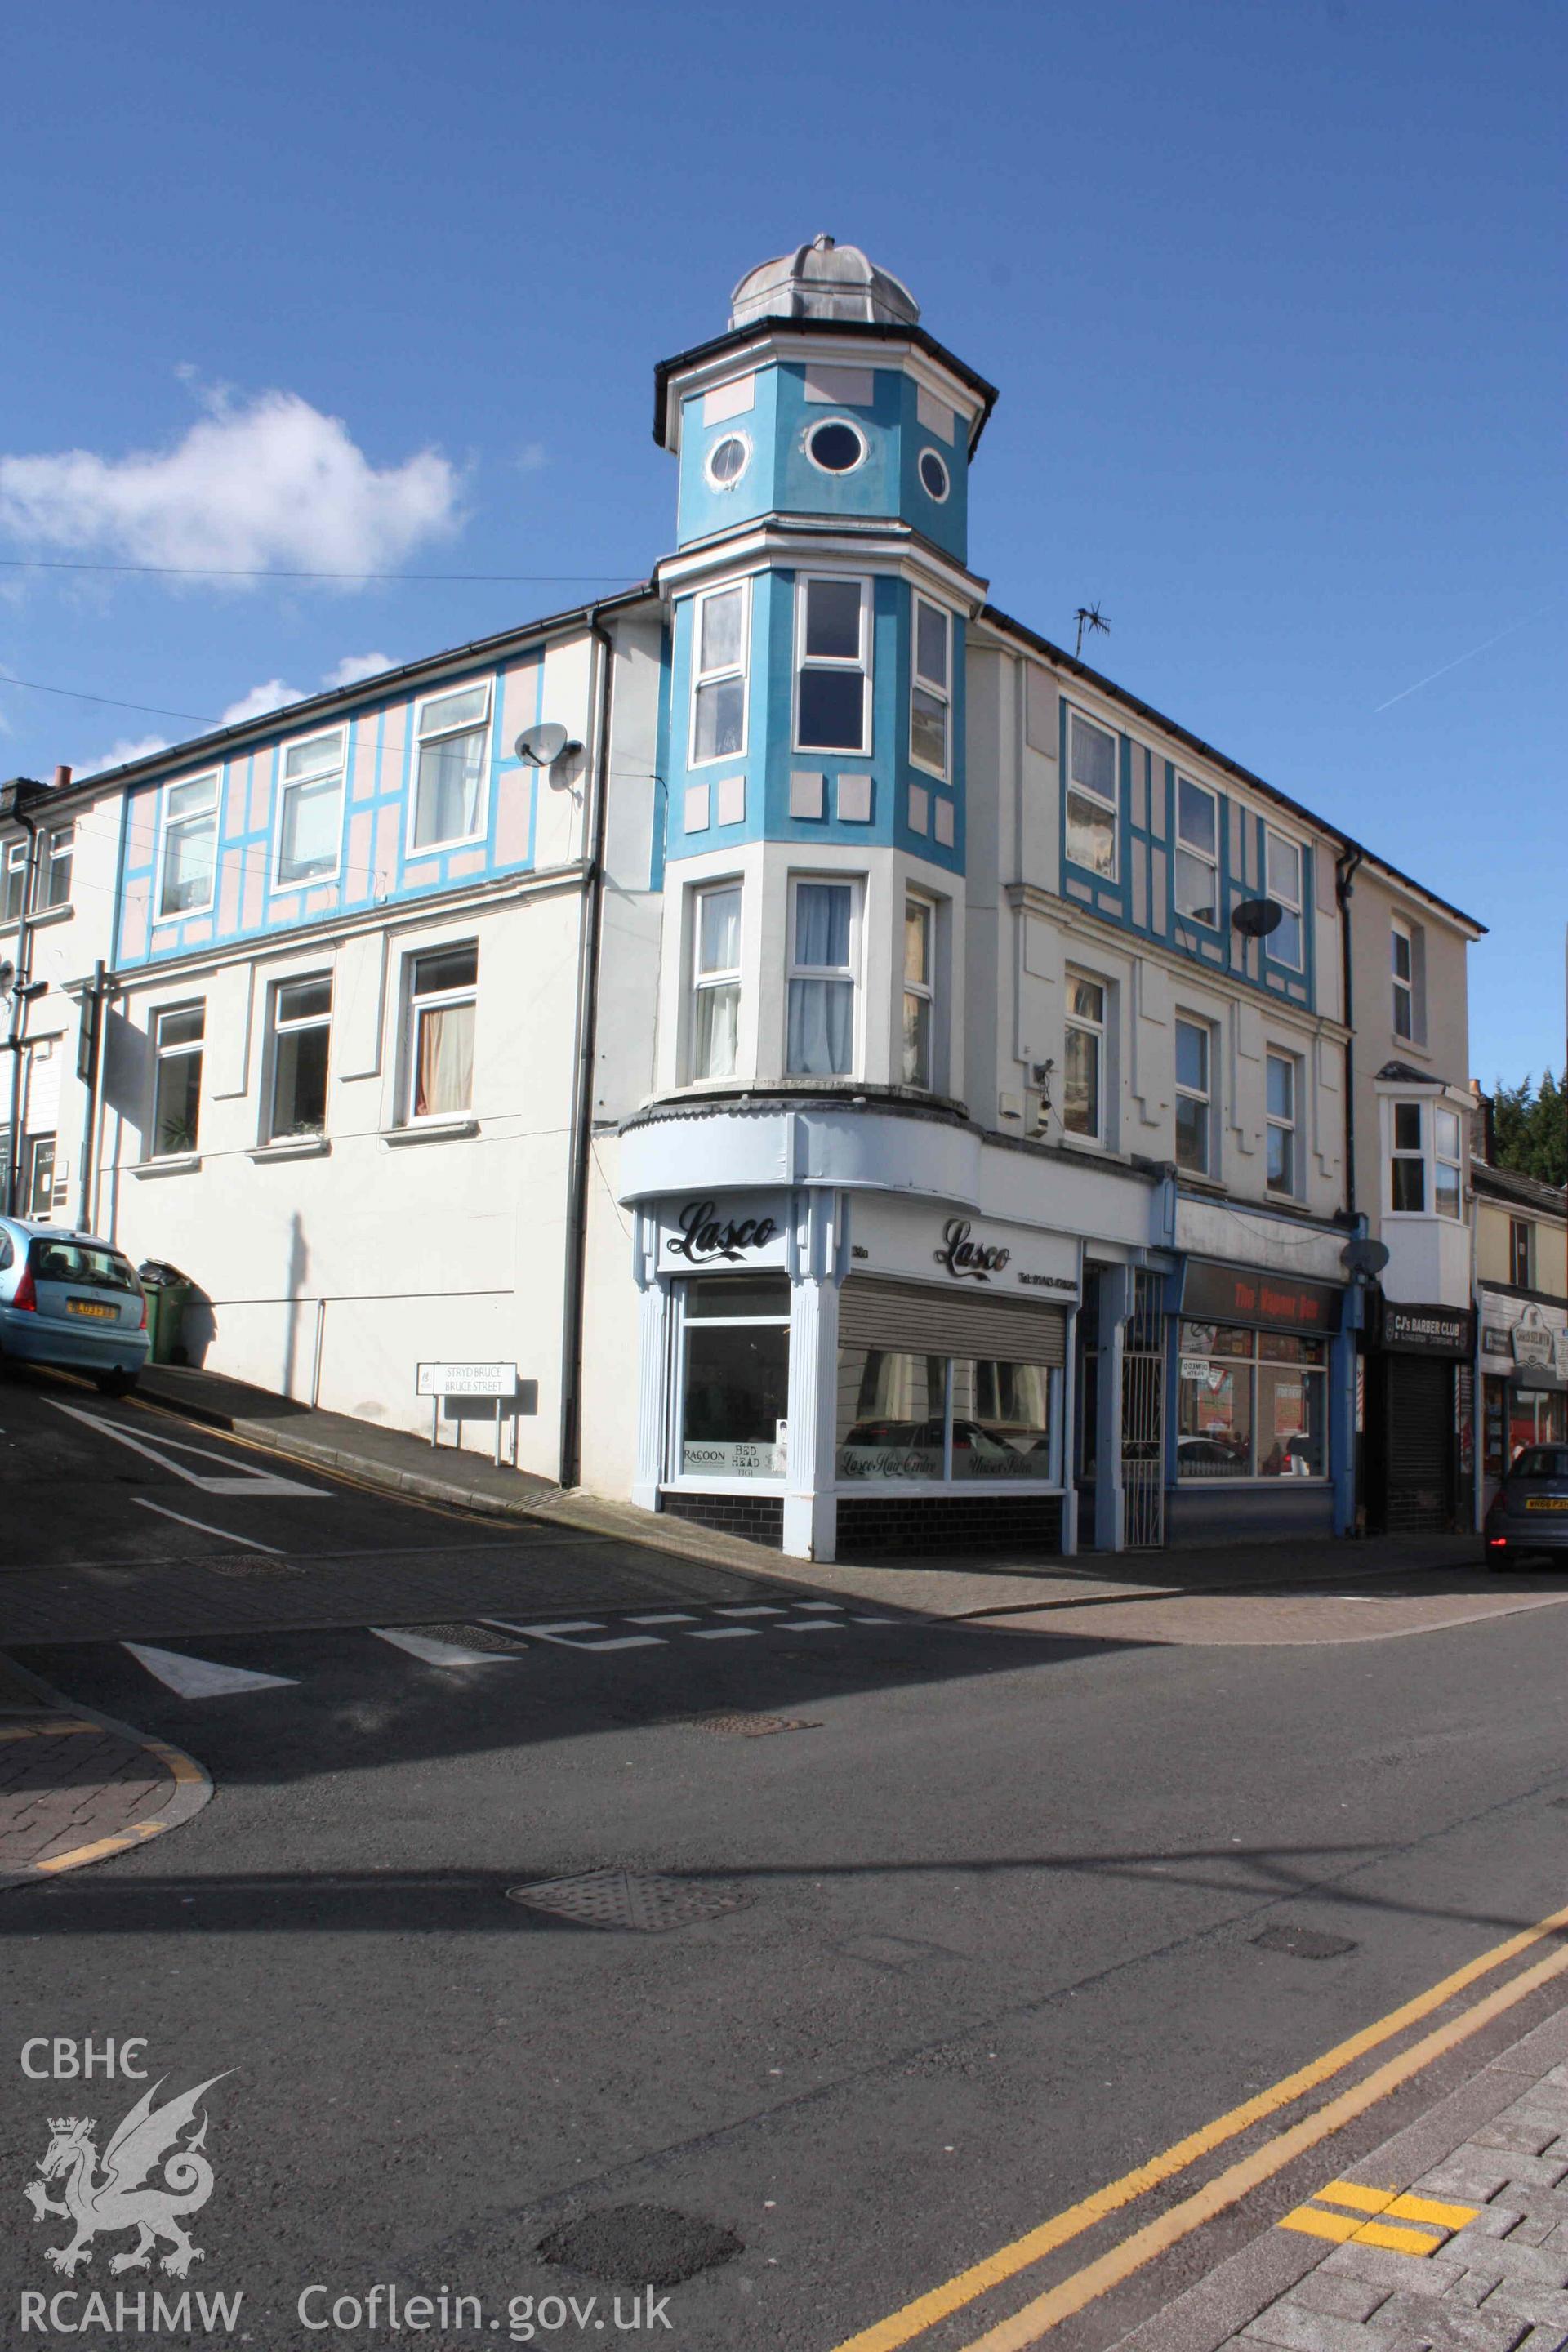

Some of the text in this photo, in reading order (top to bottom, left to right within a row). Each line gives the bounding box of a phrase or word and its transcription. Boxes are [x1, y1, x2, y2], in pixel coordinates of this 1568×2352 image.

[667, 1200, 777, 1264] Lasco
[933, 1218, 1012, 1282] Lasco
[1395, 1315, 1460, 1337] CJ's BARBER CLUB
[447, 1366, 502, 1378] STRYD BRUCE
[445, 1381, 503, 1392] BRUCE STREET
[684, 1450, 725, 1463] RACOON
[735, 1445, 756, 1456] BED
[732, 1456, 760, 1468] HEAD
